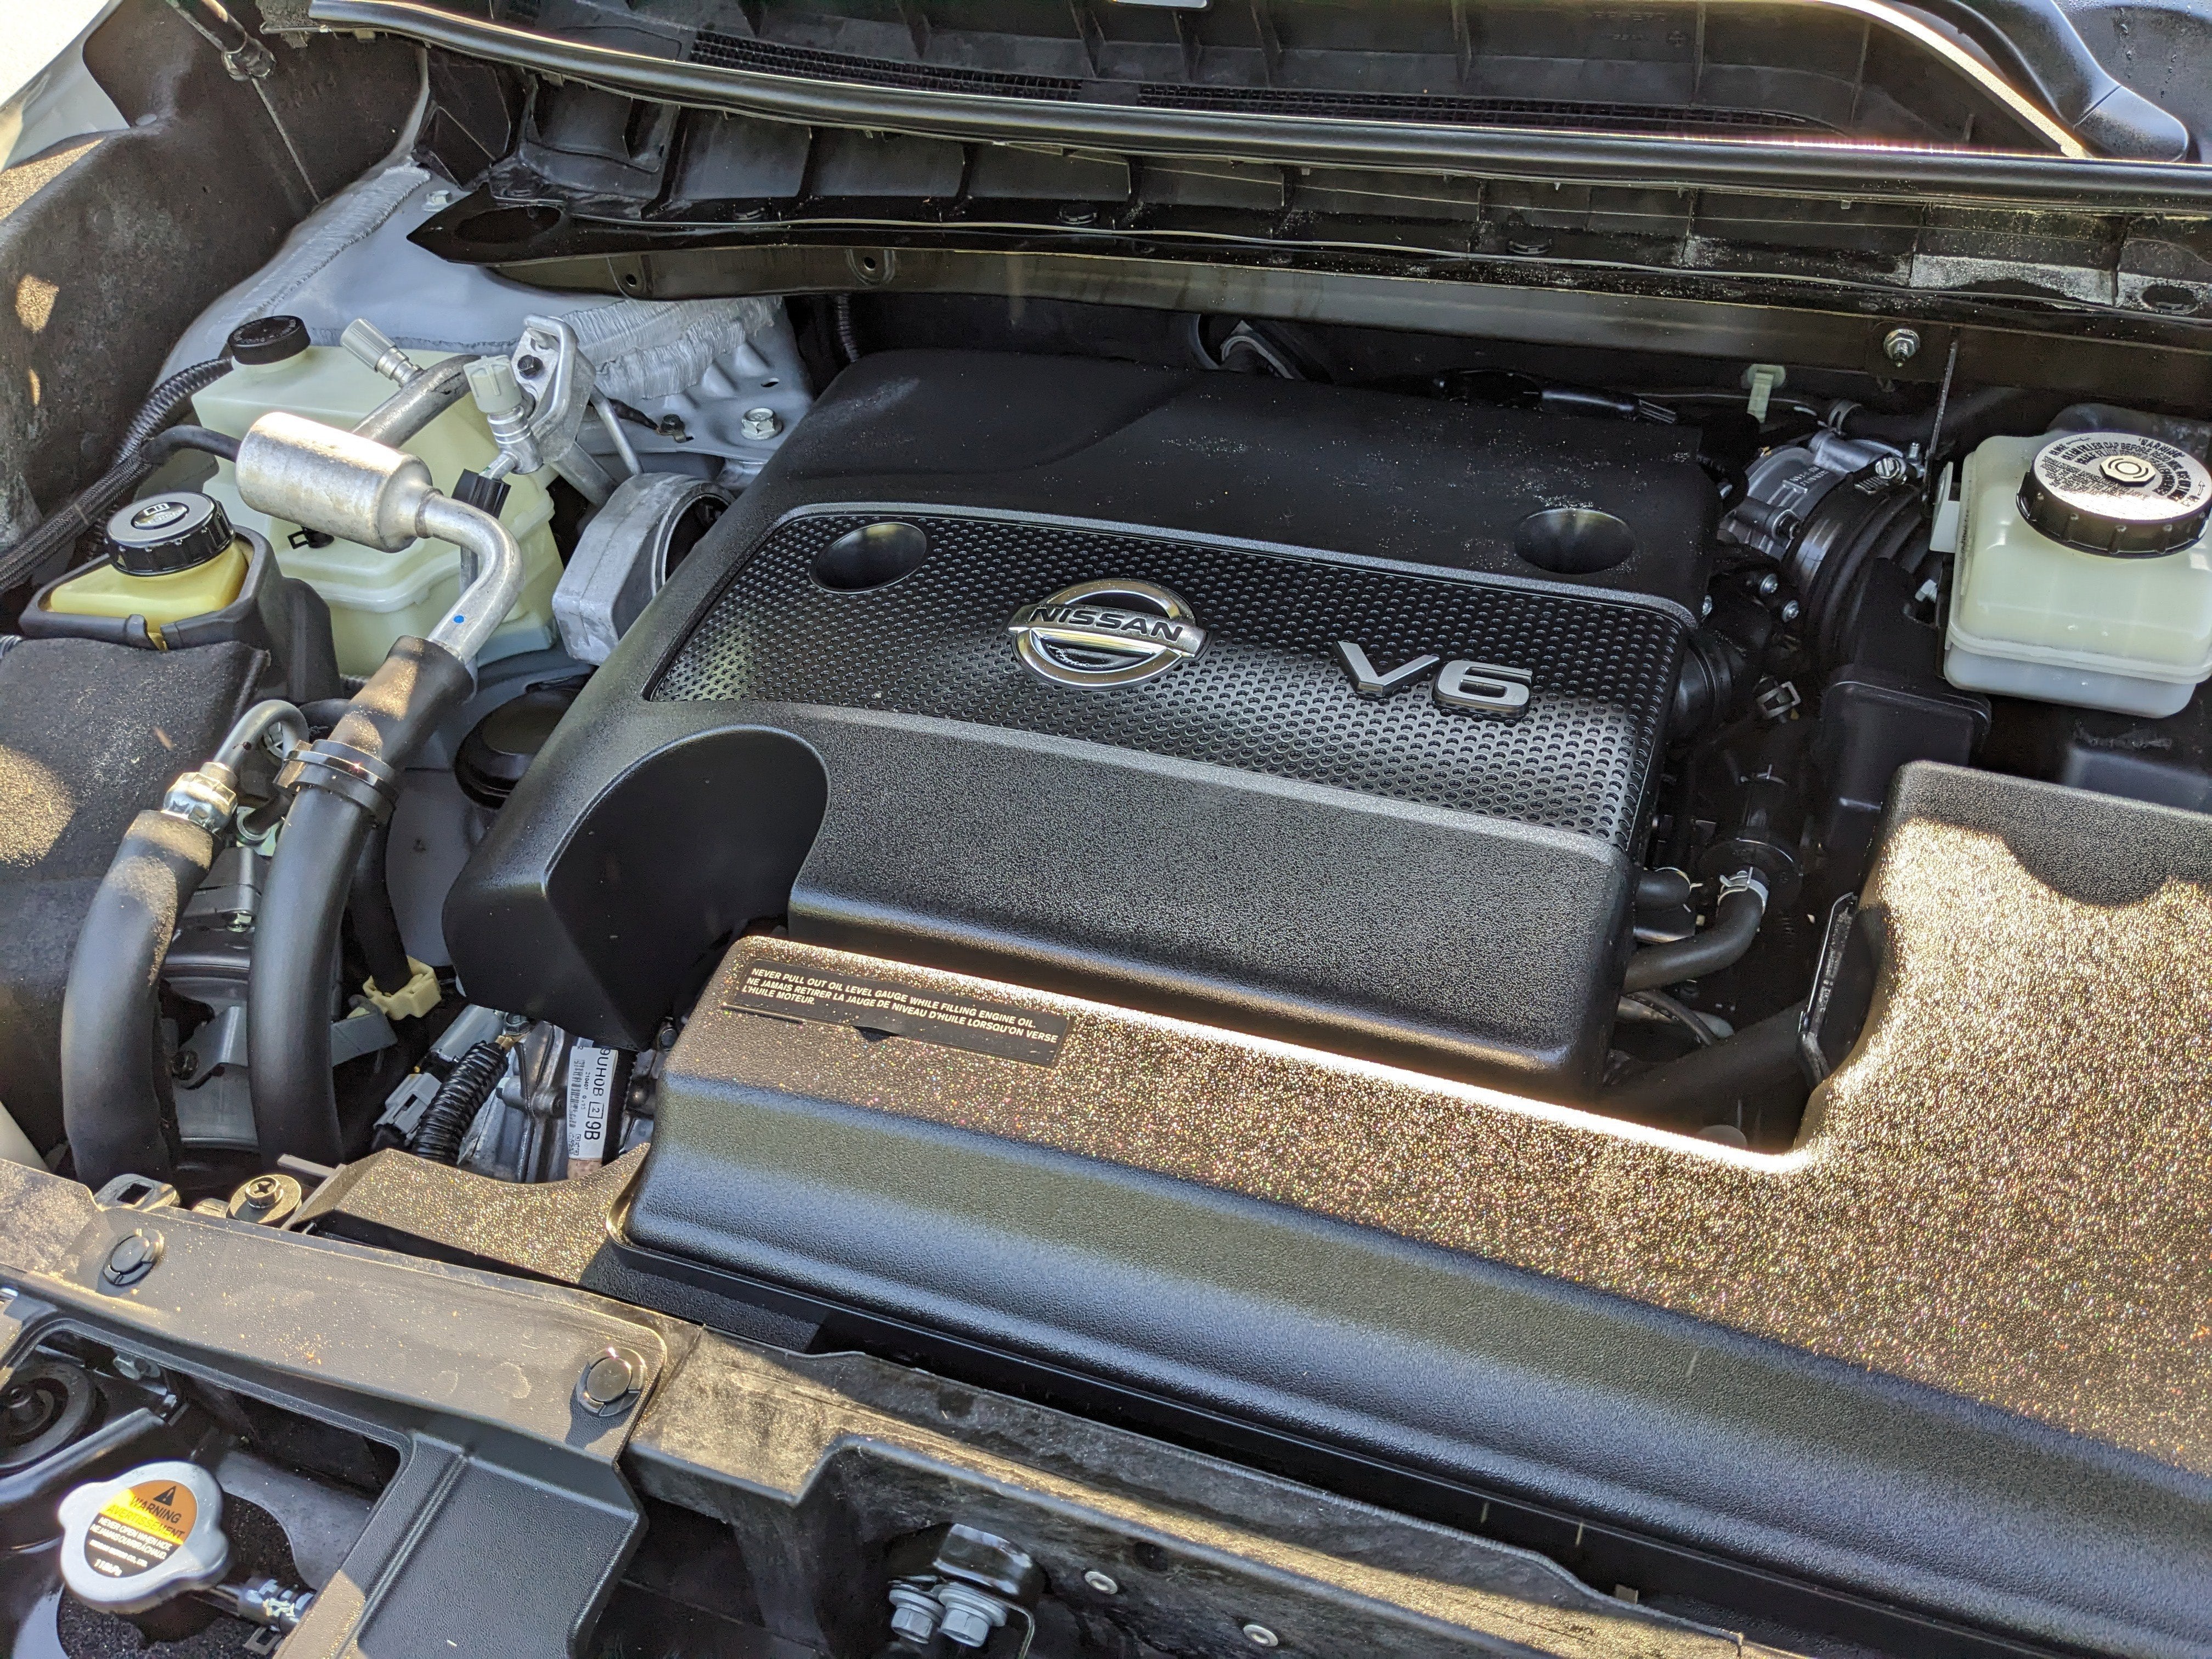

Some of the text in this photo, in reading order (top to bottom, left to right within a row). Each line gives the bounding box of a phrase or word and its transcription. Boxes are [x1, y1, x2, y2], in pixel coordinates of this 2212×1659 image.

[1030, 607, 1183, 642] NISSAN
[1335, 641, 1534, 720] V6
[742, 985, 815, 1005] L'HUILE MOTEUR.
[747, 978, 1059, 1043] NE JAMAIS RETIRER LA JAUGE DE NIVEAU D'HUILE LORSQU'ON VERSE
[752, 968, 1036, 1028] NEVER PULL OUT OIL LEVEL GAUGE WHILE FILLING ENGINE OIL.
[584, 1121, 602, 1140] 9B
[106, 1504, 185, 1539] AVERTISSEMENT
[129, 1496, 182, 1524] WARNING
[90, 1524, 102, 1533] NE
[98, 1517, 121, 1531] NEVER
[119, 1525, 138, 1538] OPEN
[137, 1532, 158, 1545] WHEN
